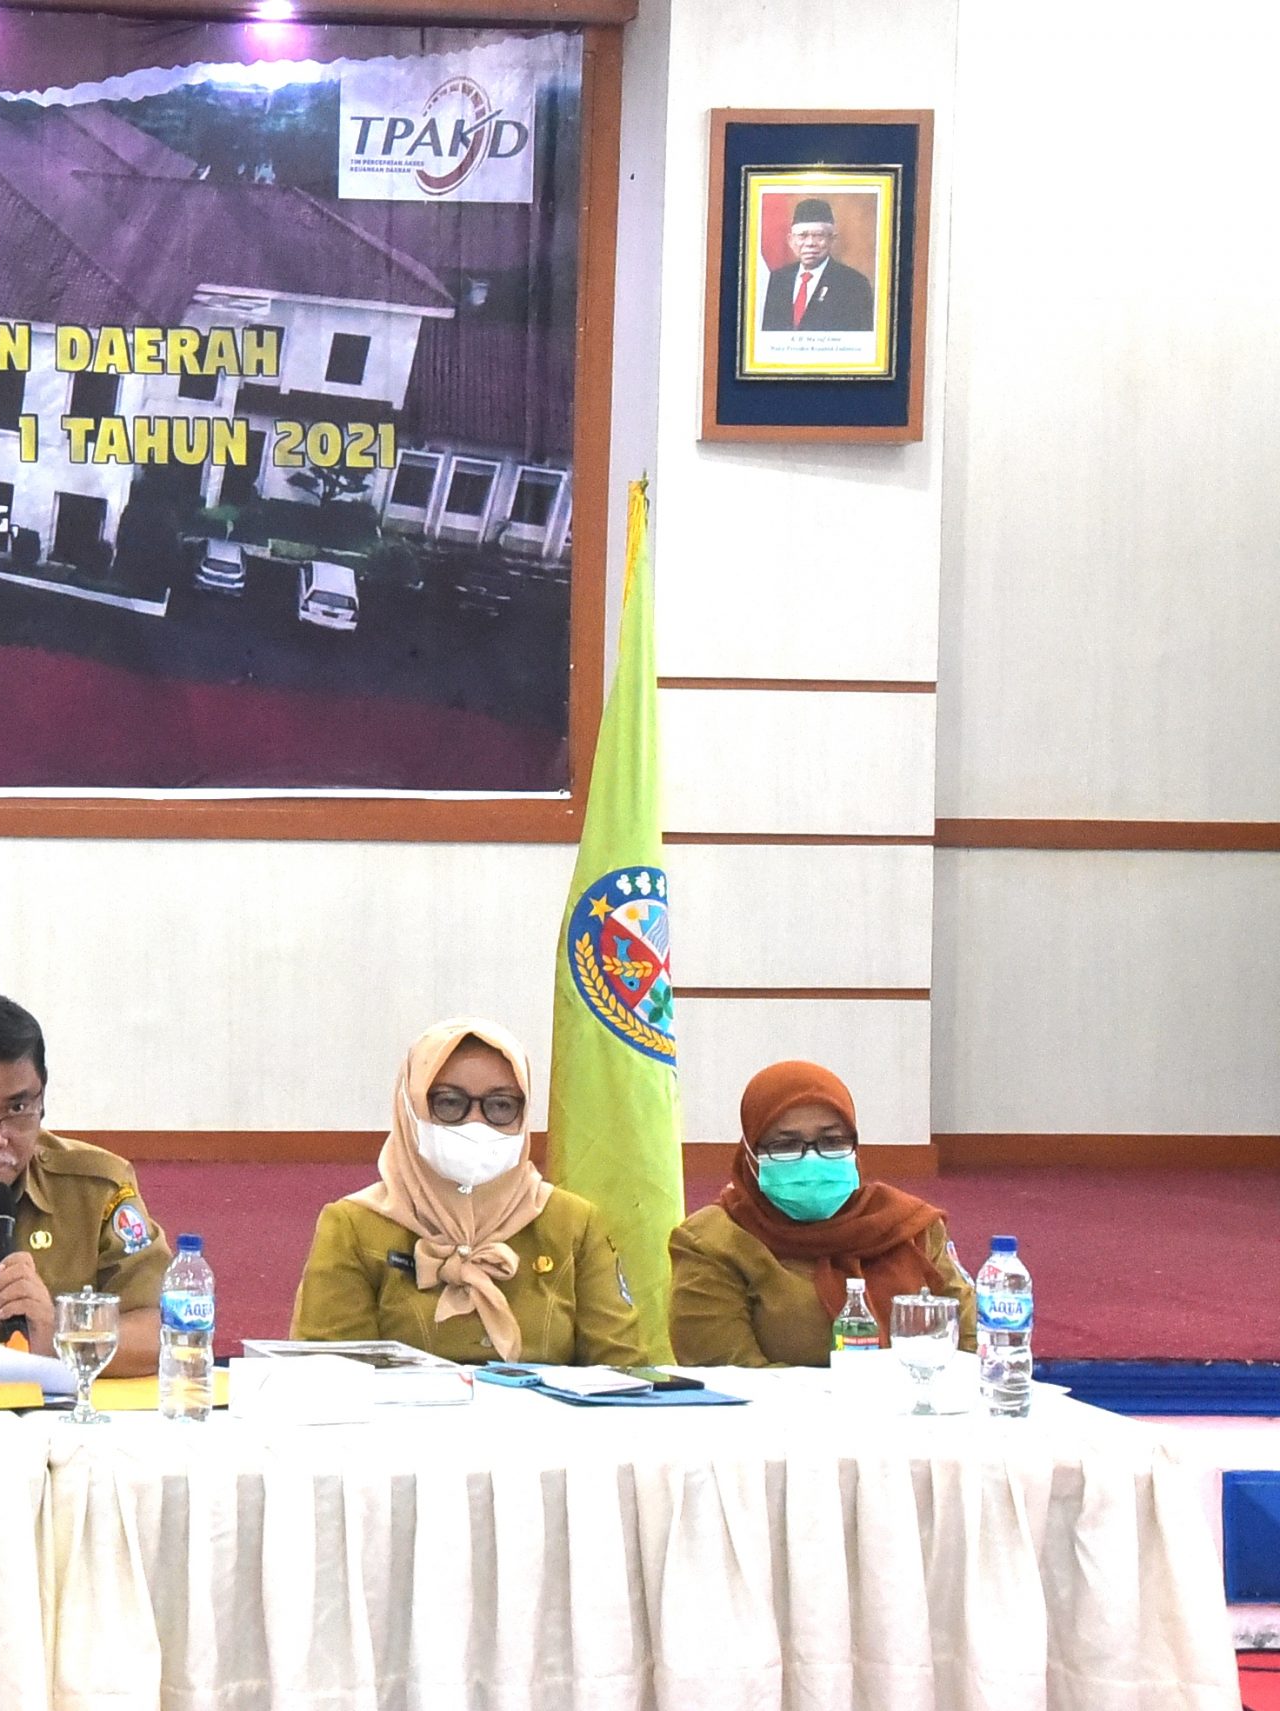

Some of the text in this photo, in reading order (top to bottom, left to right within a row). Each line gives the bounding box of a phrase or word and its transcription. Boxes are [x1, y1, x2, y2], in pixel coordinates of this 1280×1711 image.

[350, 109, 529, 158] TPAKD
[56, 326, 279, 377] DAERAH
[62, 416, 248, 467] TAHUN
[272, 422, 397, 469] 2021
[989, 1301, 1023, 1316] AQUA
